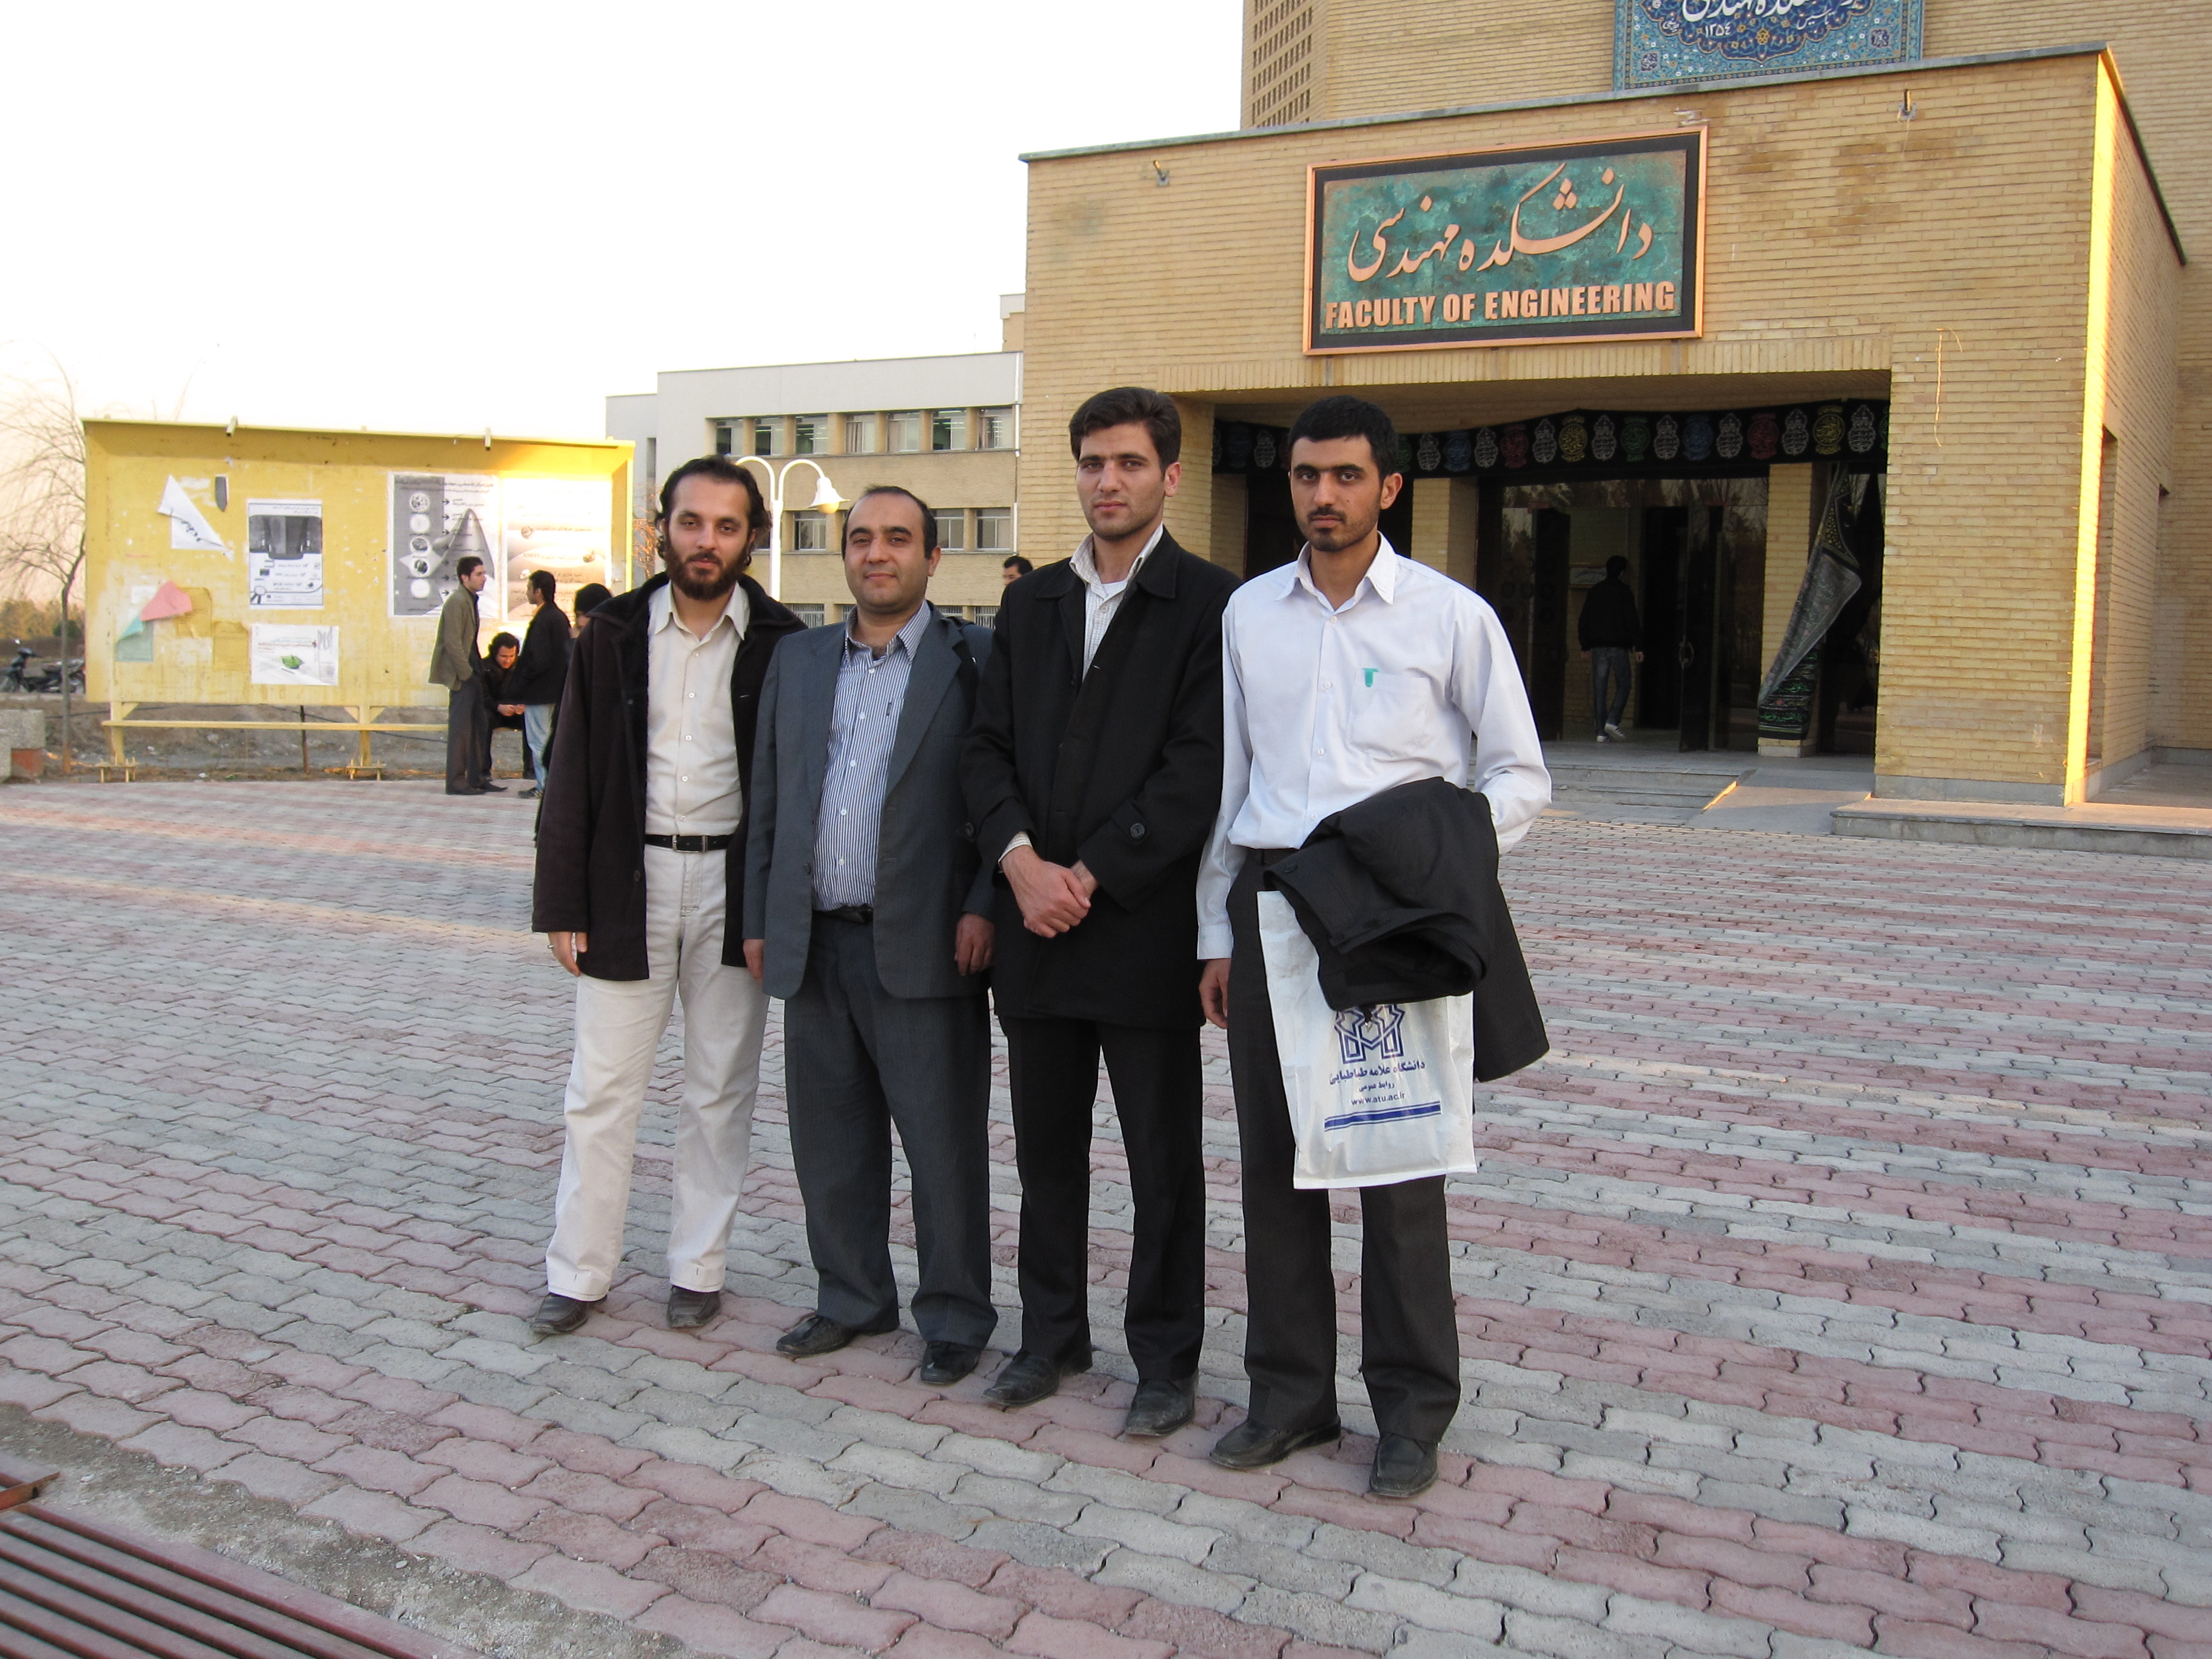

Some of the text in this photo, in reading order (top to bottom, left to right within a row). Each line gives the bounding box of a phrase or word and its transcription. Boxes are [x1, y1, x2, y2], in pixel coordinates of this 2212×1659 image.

[1347, 162, 1653, 282] دانشکده مهندسی
[1325, 281, 1675, 329] FACULTY OF ENGINEERING
[1369, 1063, 1391, 1076] علامه
[1393, 1060, 1426, 1073] دانشگاه
[1359, 1081, 1395, 1092] روابط عمومی
